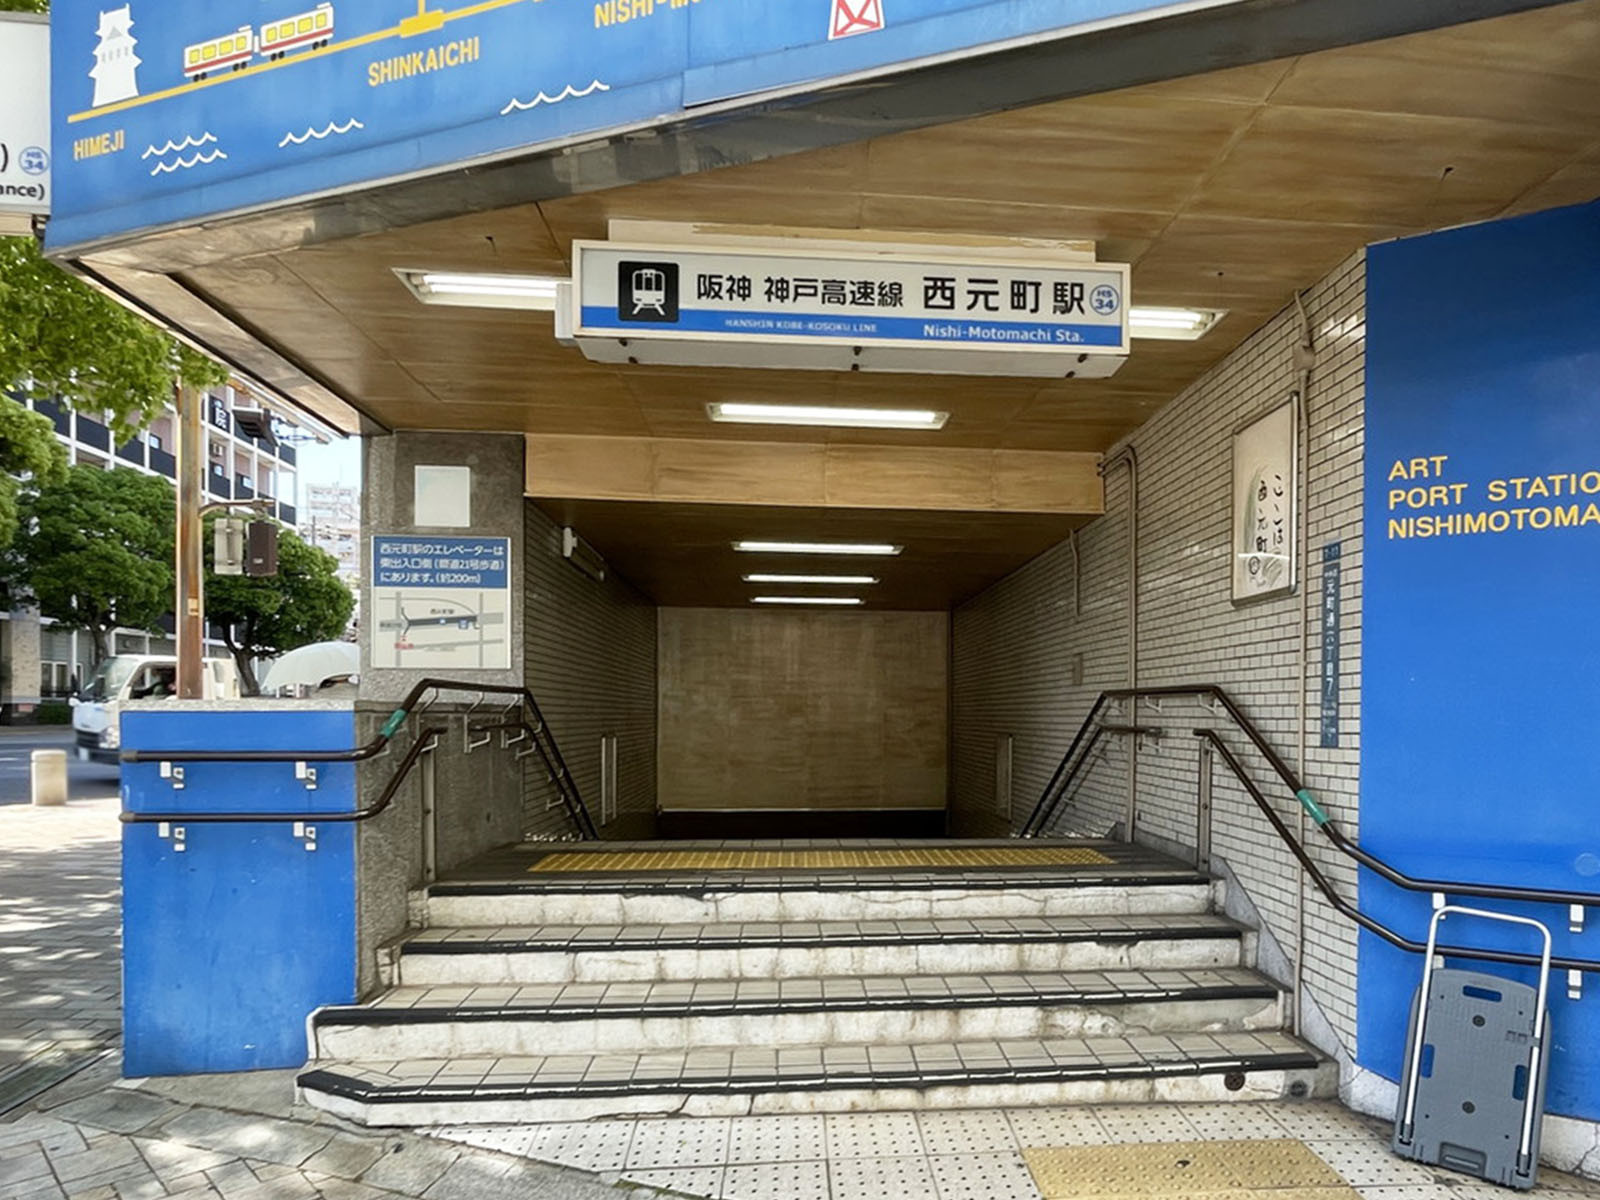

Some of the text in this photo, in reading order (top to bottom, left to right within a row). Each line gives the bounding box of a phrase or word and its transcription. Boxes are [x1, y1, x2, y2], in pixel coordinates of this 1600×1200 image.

[594, 0, 701, 28] NISHI-
[367, 36, 480, 87] SHINKAICHI
[73, 129, 125, 161] HIMEJI
[25, 160, 44, 170] 34
[696, 273, 1086, 315] 阪神 神戸高速線 西元町駅
[1094, 299, 1114, 310] 34
[725, 318, 877, 333] HANSHIN KOBE-KOSOKU LINE
[923, 324, 1085, 342] Nishi-Motomachi Sta.
[1388, 455, 1449, 481] ART
[1388, 470, 1600, 511] PORT STATIO
[1388, 502, 1600, 540] NISHIMOTOMA
